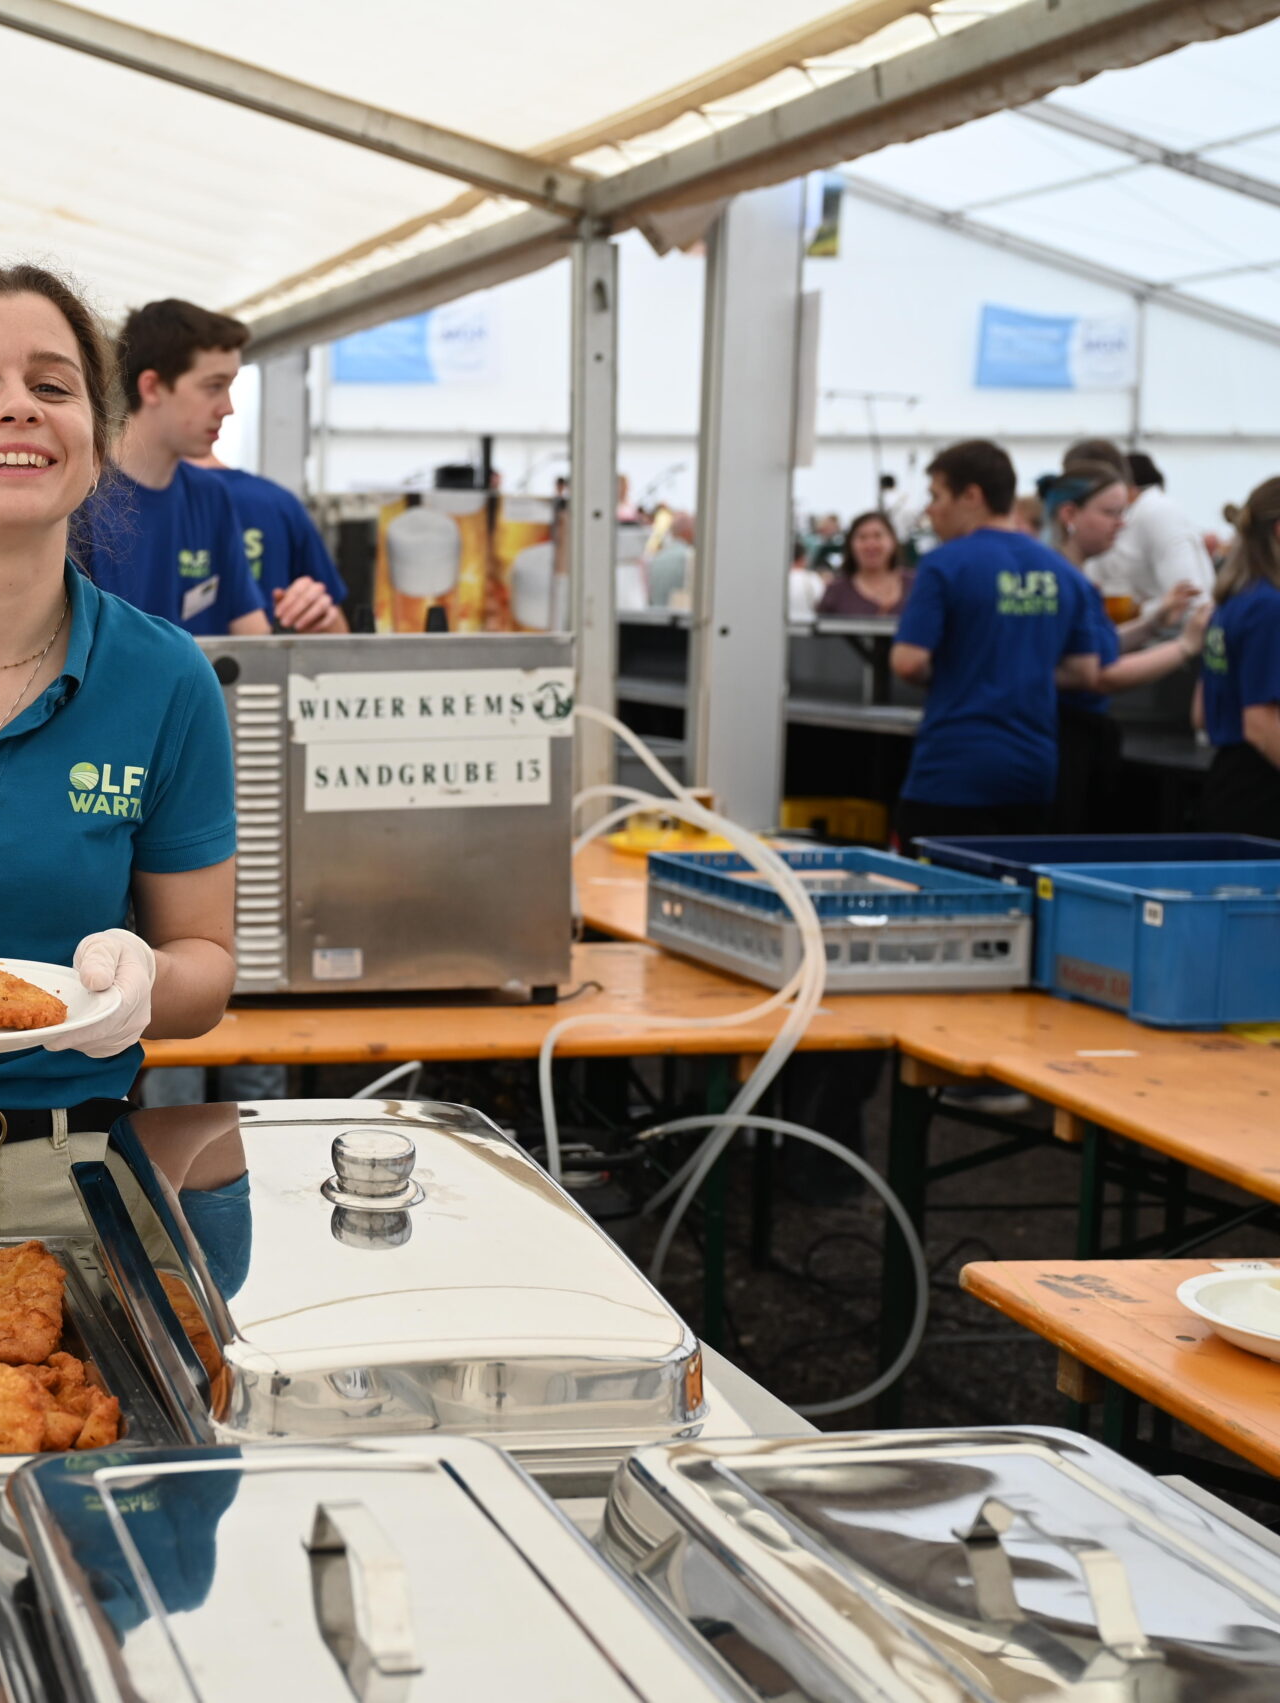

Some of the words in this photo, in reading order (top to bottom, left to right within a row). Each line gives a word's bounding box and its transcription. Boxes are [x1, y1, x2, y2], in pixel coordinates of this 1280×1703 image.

[299, 697, 406, 720] WINZER
[418, 694, 524, 717] KREMS
[101, 763, 148, 795] LF
[314, 761, 497, 788] SANDGRUBE
[516, 758, 542, 782] 13
